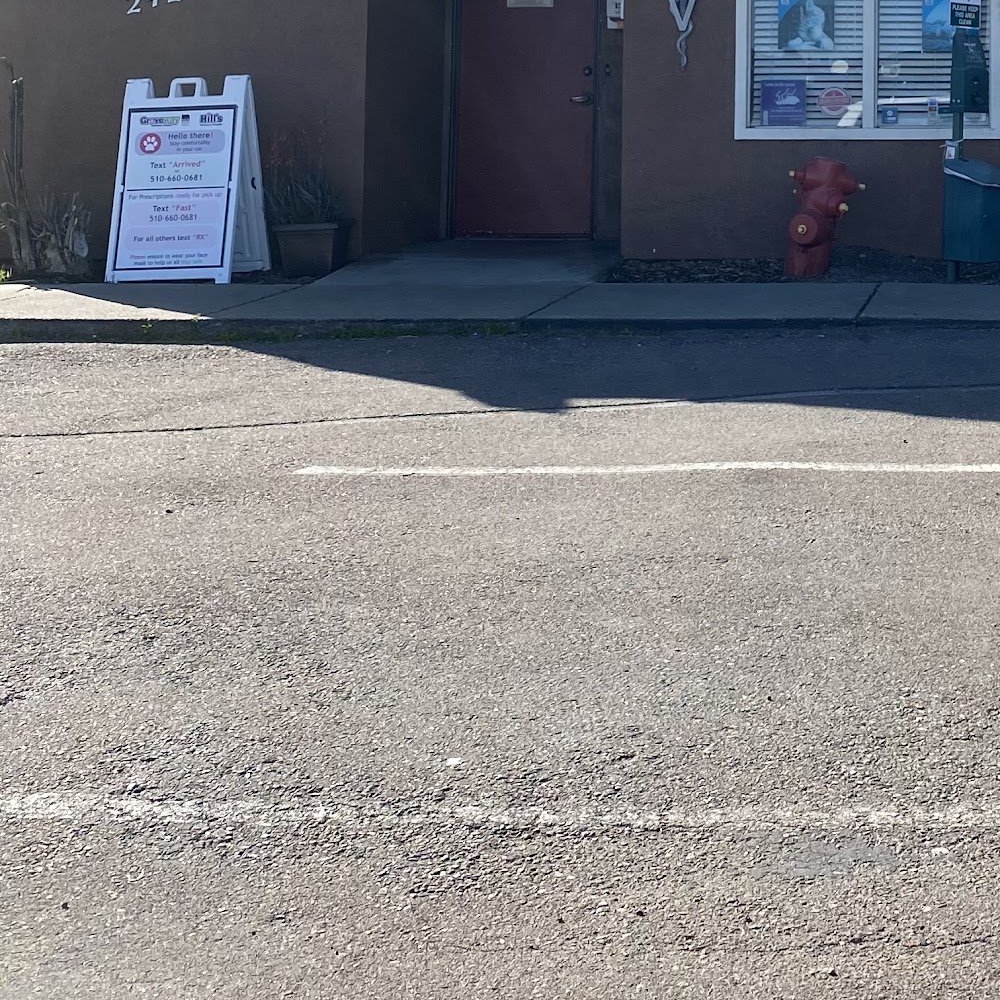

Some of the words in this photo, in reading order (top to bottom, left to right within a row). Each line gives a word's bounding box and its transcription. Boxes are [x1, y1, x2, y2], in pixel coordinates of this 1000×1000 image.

[200, 113, 223, 123] Hill's
[150, 174, 203, 182] 510-660-0681
[149, 214, 197, 222] 510-660-0681
